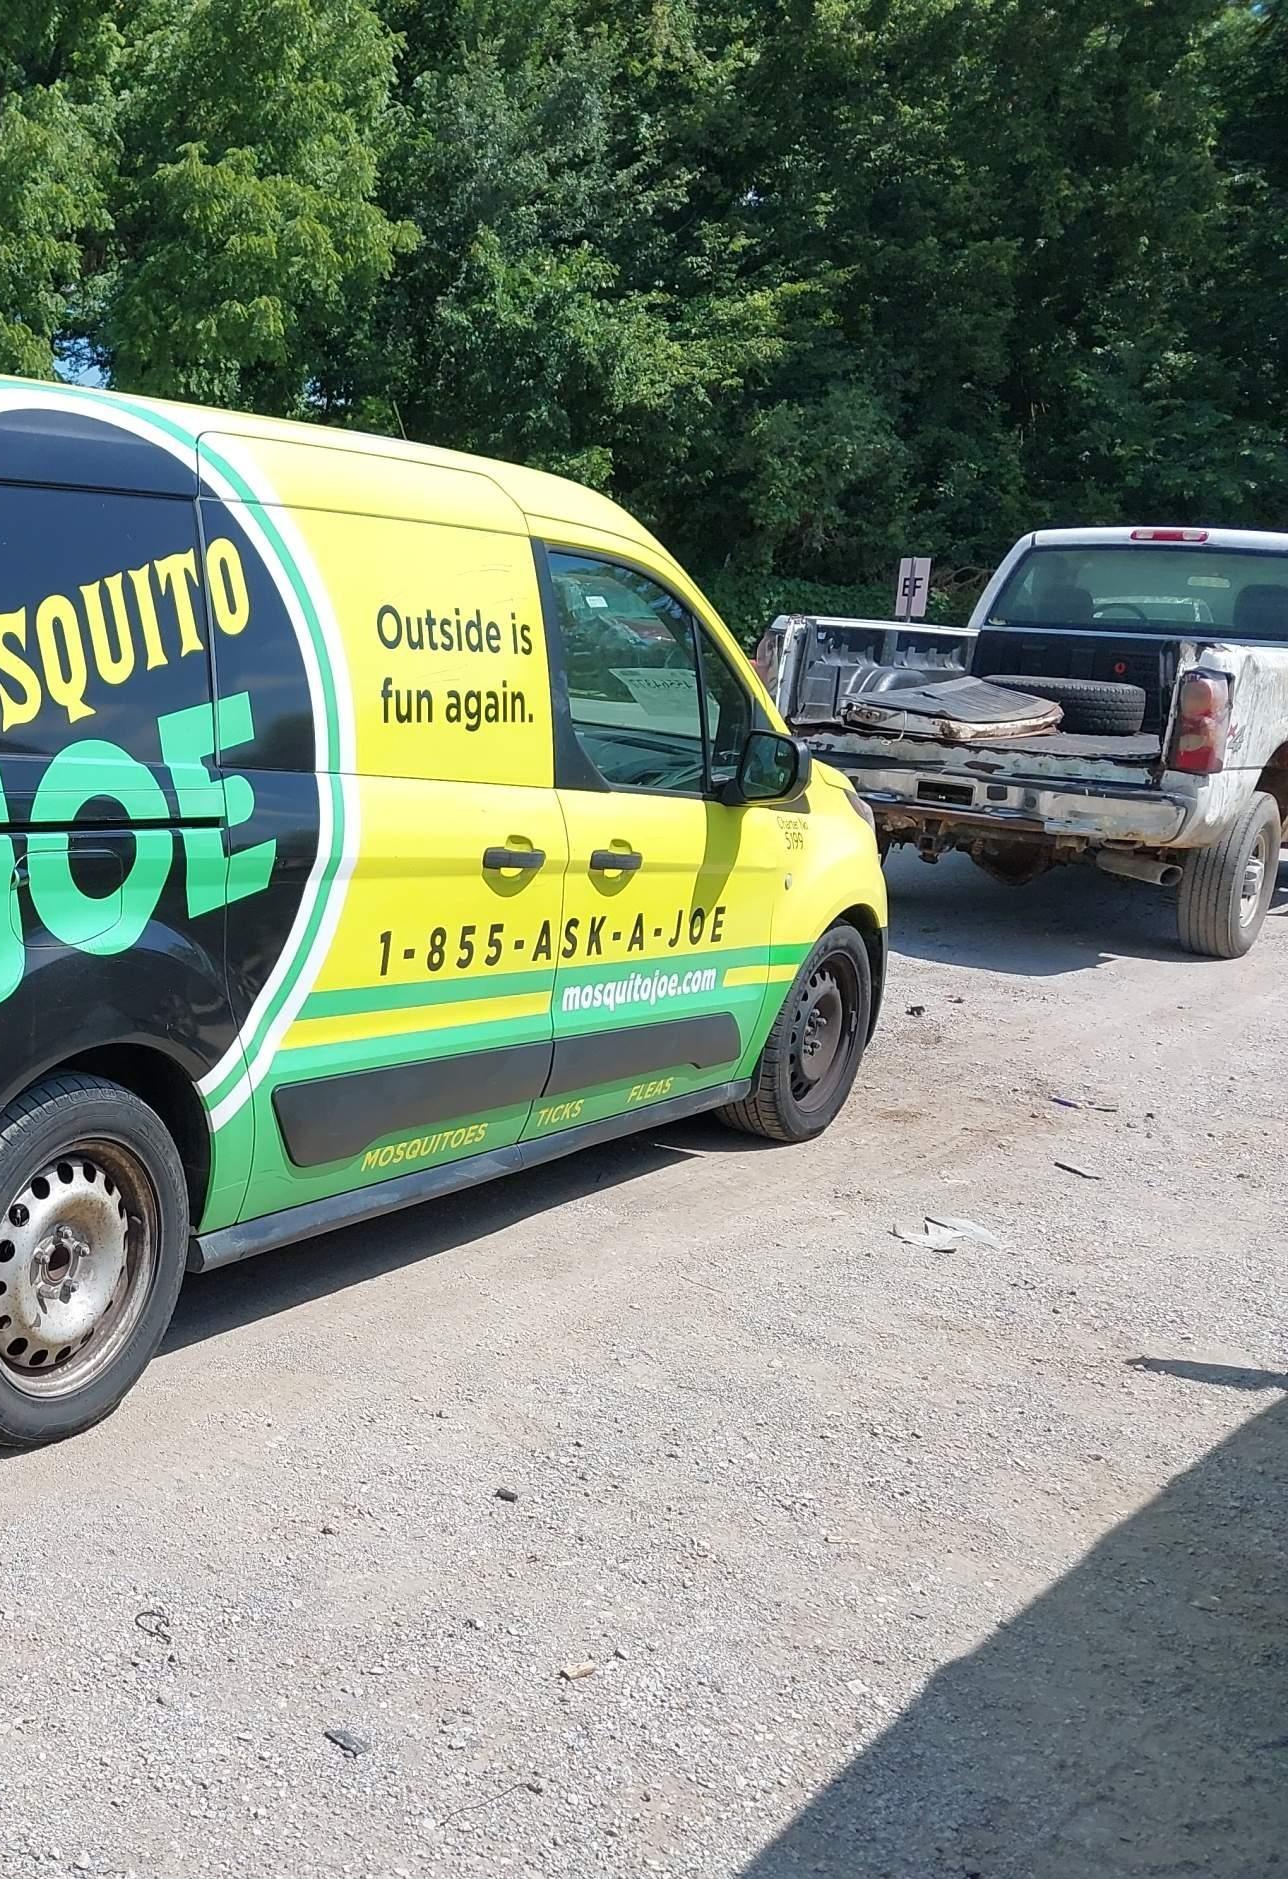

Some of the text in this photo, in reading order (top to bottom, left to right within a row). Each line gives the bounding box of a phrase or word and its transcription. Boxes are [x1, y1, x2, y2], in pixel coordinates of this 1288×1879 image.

[377, 604, 533, 656] Outside is
[381, 677, 534, 732] fun again.
[379, 906, 727, 977] 1-855-ASK-A-JOE
[562, 968, 717, 1012] mosquitojoe.com
[360, 1076, 675, 1172] MOSQUITOES TICKS FLEAS
